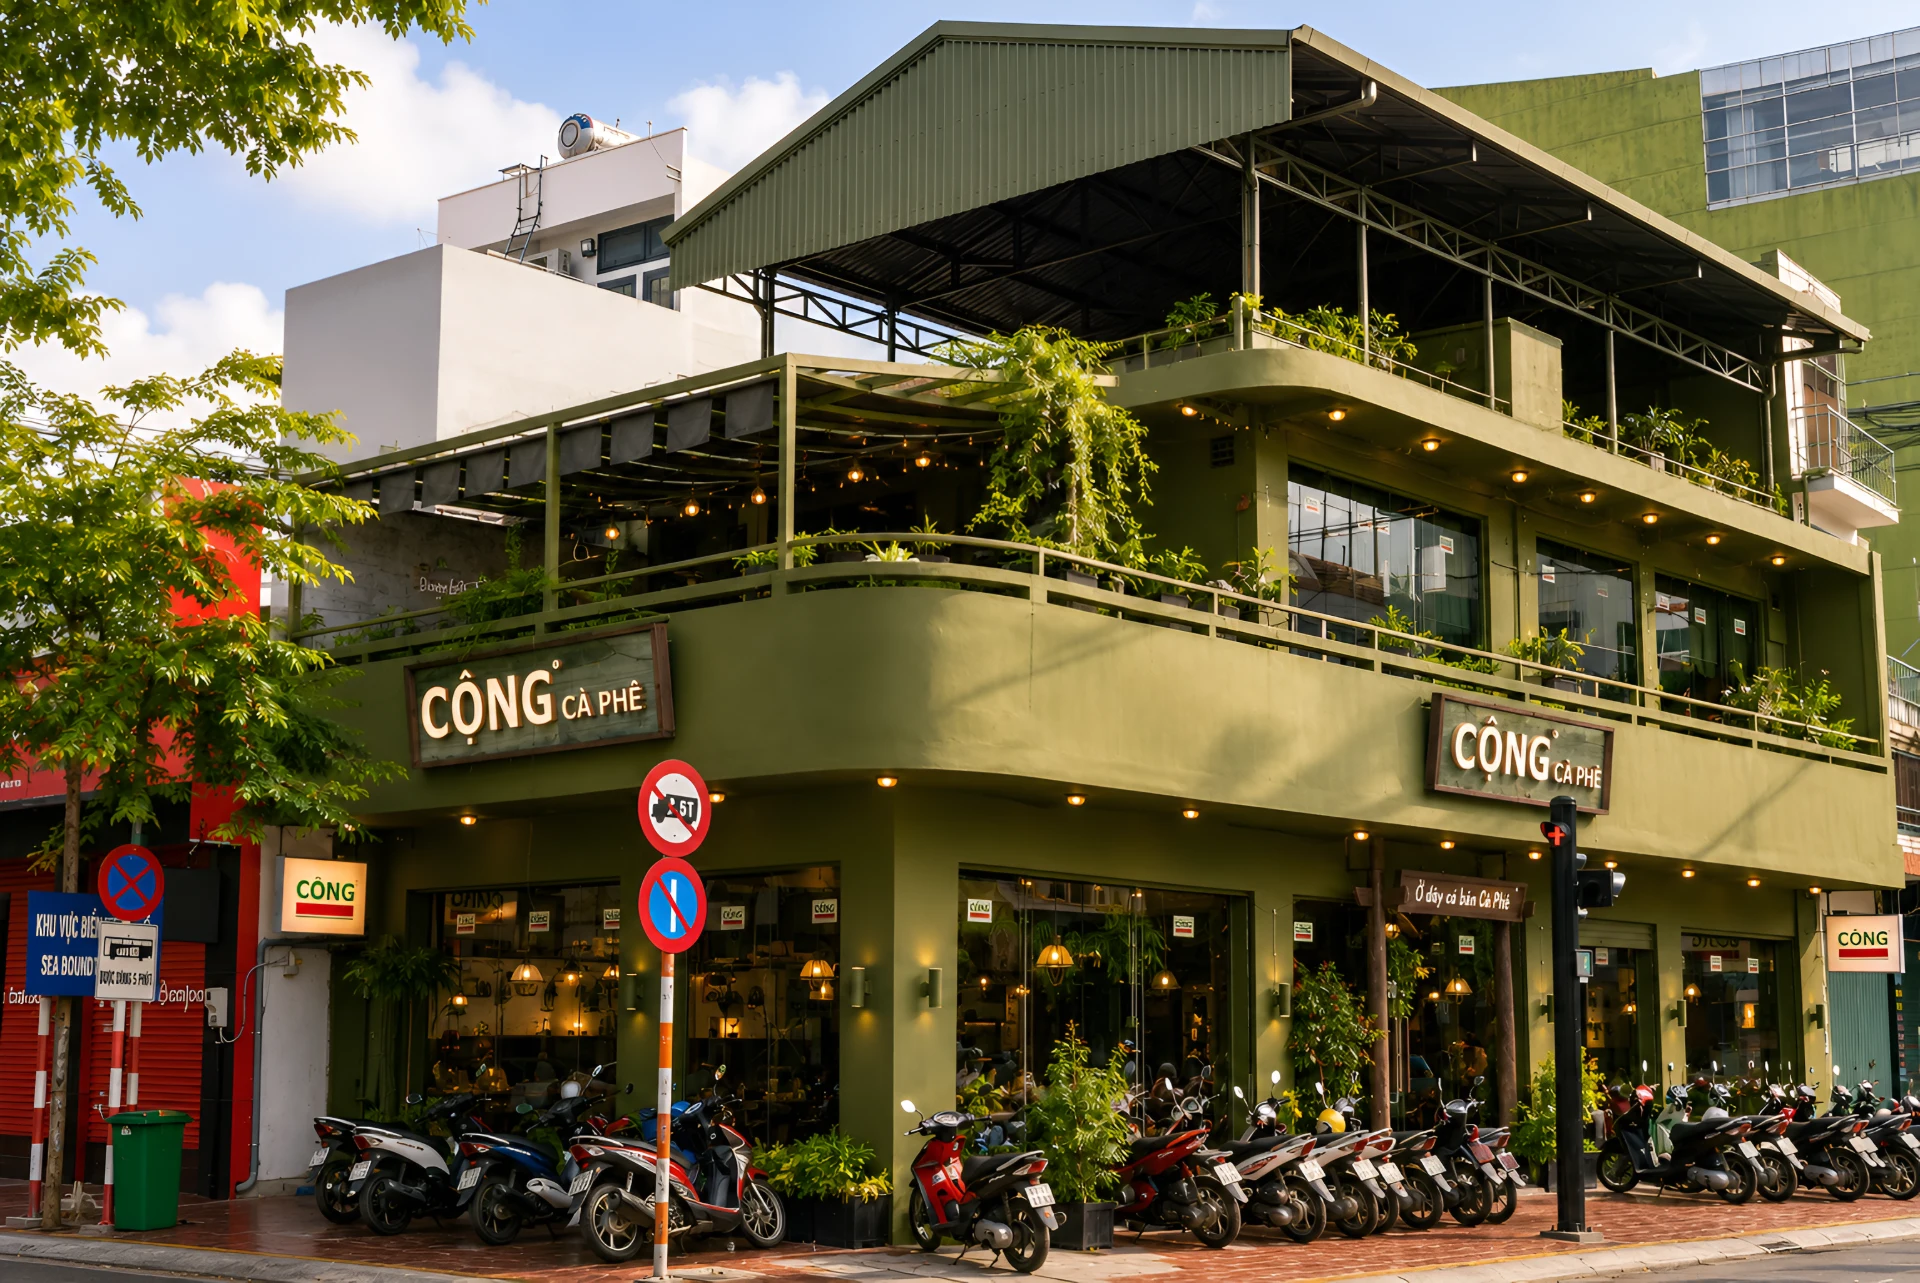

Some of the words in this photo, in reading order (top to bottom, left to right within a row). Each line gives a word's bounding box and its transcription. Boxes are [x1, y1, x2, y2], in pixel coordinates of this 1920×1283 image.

[422, 669, 554, 745] CỘNG
[562, 688, 592, 720] CÀ
[599, 680, 644, 715] PHÊ
[1453, 716, 1550, 781] CỘNG
[1553, 759, 1572, 785] CÀ
[36, 913, 57, 937] KHU
[41, 954, 59, 976] SEA
